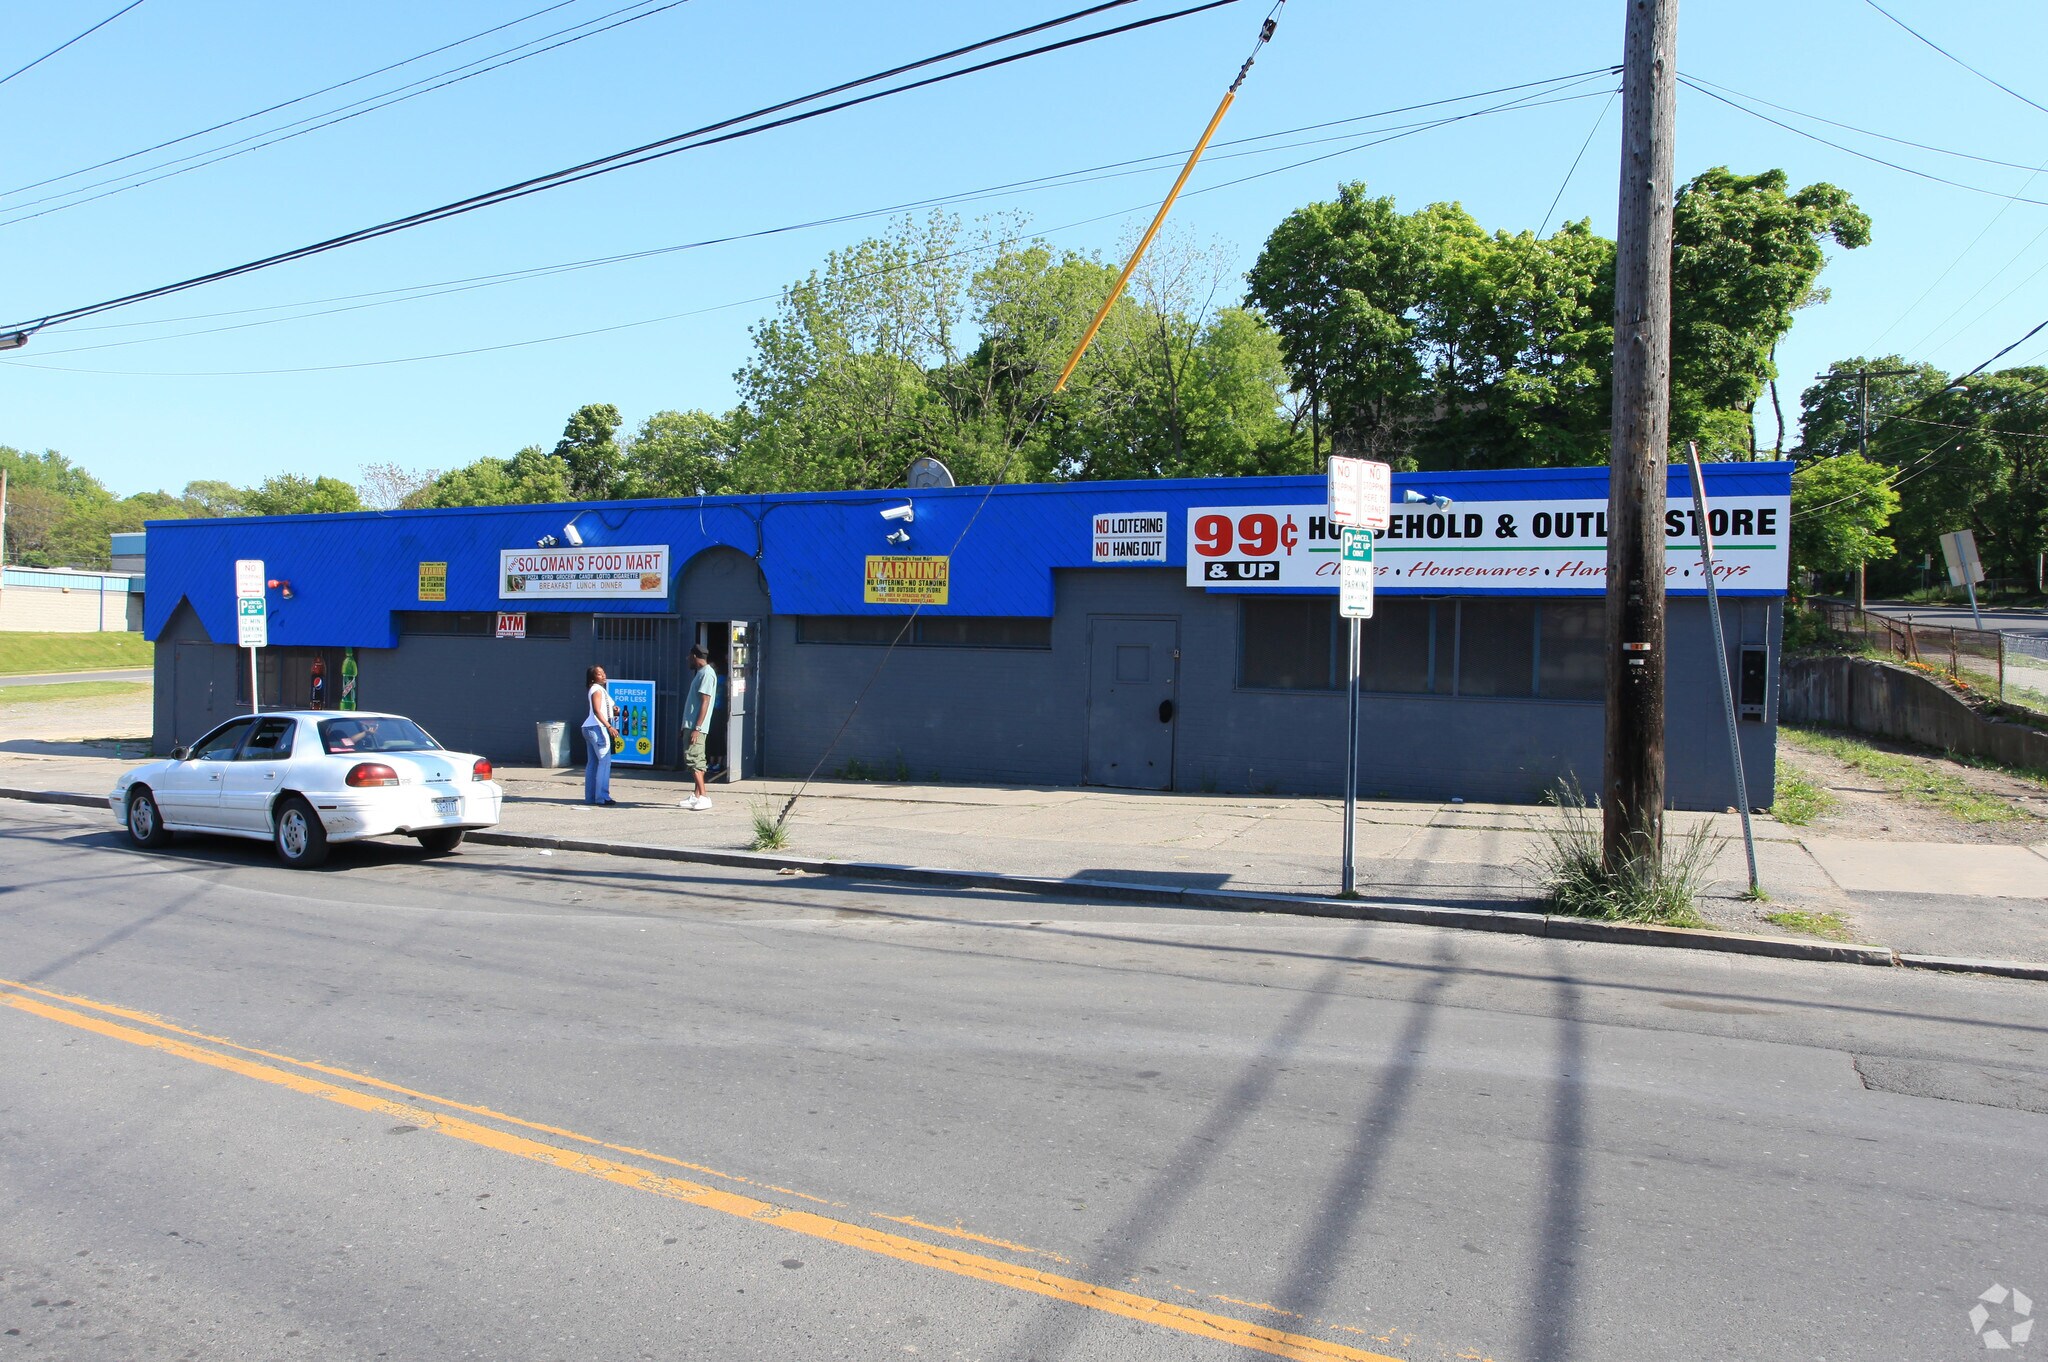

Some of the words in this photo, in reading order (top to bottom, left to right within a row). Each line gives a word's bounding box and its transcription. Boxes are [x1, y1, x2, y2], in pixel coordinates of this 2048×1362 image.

[1338, 465, 1350, 478] NO
[1370, 468, 1381, 480] NO
[1096, 519, 1109, 534] NO
[1112, 518, 1163, 534] LOITERING
[1496, 514, 1518, 538] &
[1665, 508, 1776, 537] STORE
[1096, 542, 1108, 556] NO
[518, 556, 584, 572] SOLOMAN'S
[588, 555, 621, 571] FOOD
[626, 554, 660, 570] MART
[868, 562, 946, 578] WARNING
[1208, 564, 1228, 578] &
[1238, 564, 1275, 578] UP
[1344, 566, 1351, 576] 12
[1354, 567, 1366, 576] MIN
[1408, 561, 1539, 577] Housewares
[1694, 560, 1750, 581] Toys
[1344, 580, 1368, 592] PARKING
[499, 616, 523, 631] ATM
